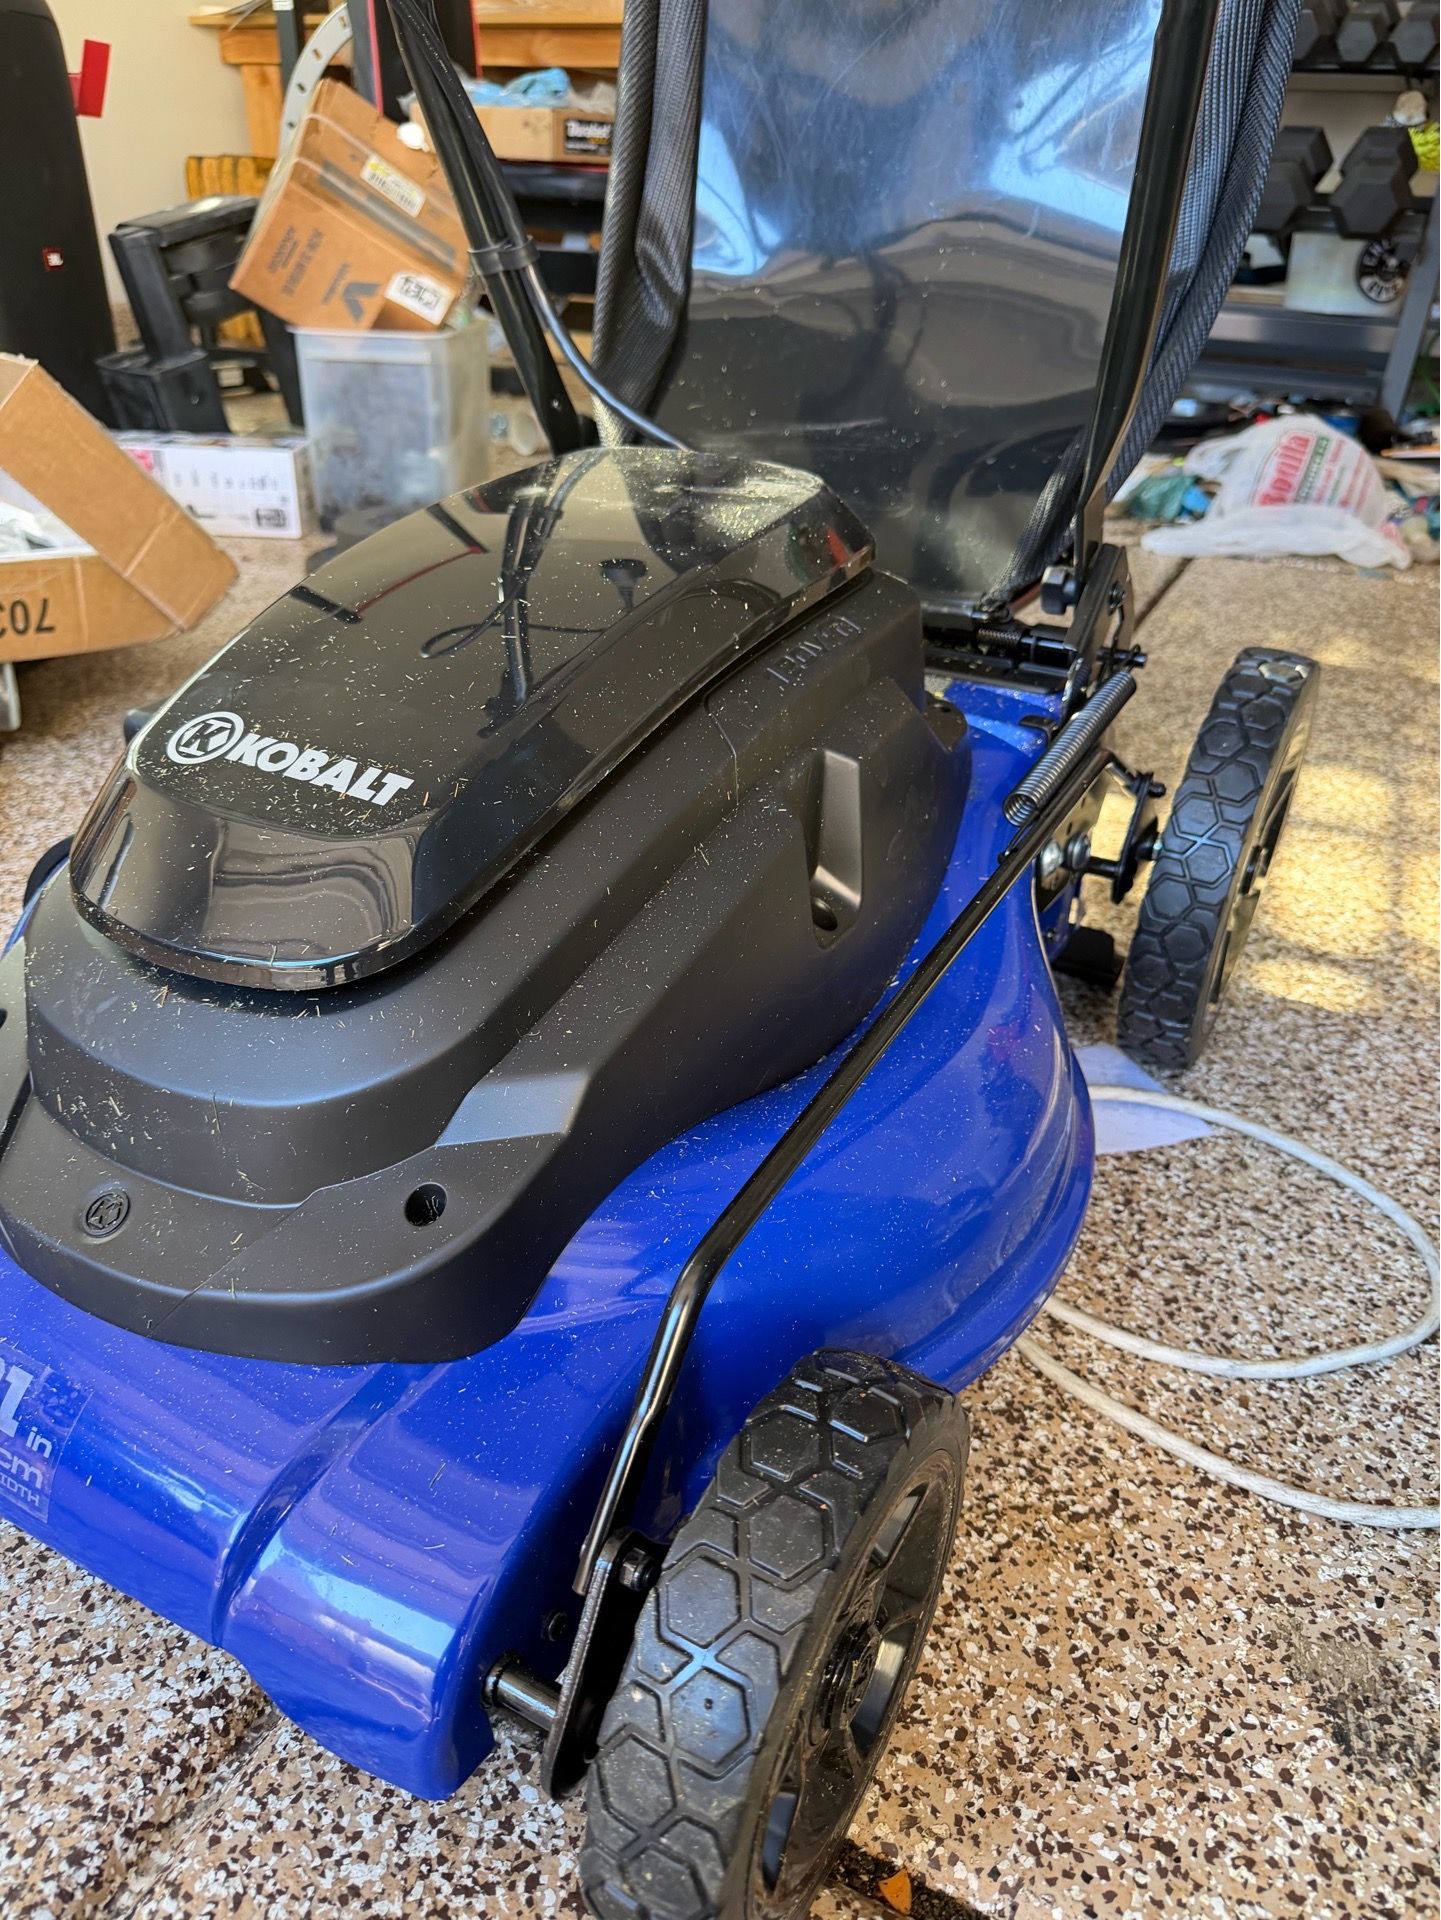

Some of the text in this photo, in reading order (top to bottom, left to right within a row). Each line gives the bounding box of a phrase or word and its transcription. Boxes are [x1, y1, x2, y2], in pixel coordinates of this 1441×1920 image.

[224, 733, 415, 806] KOBALT
[0, 1357, 53, 1459] 1 in
[0, 1472, 40, 1507] IDTH
